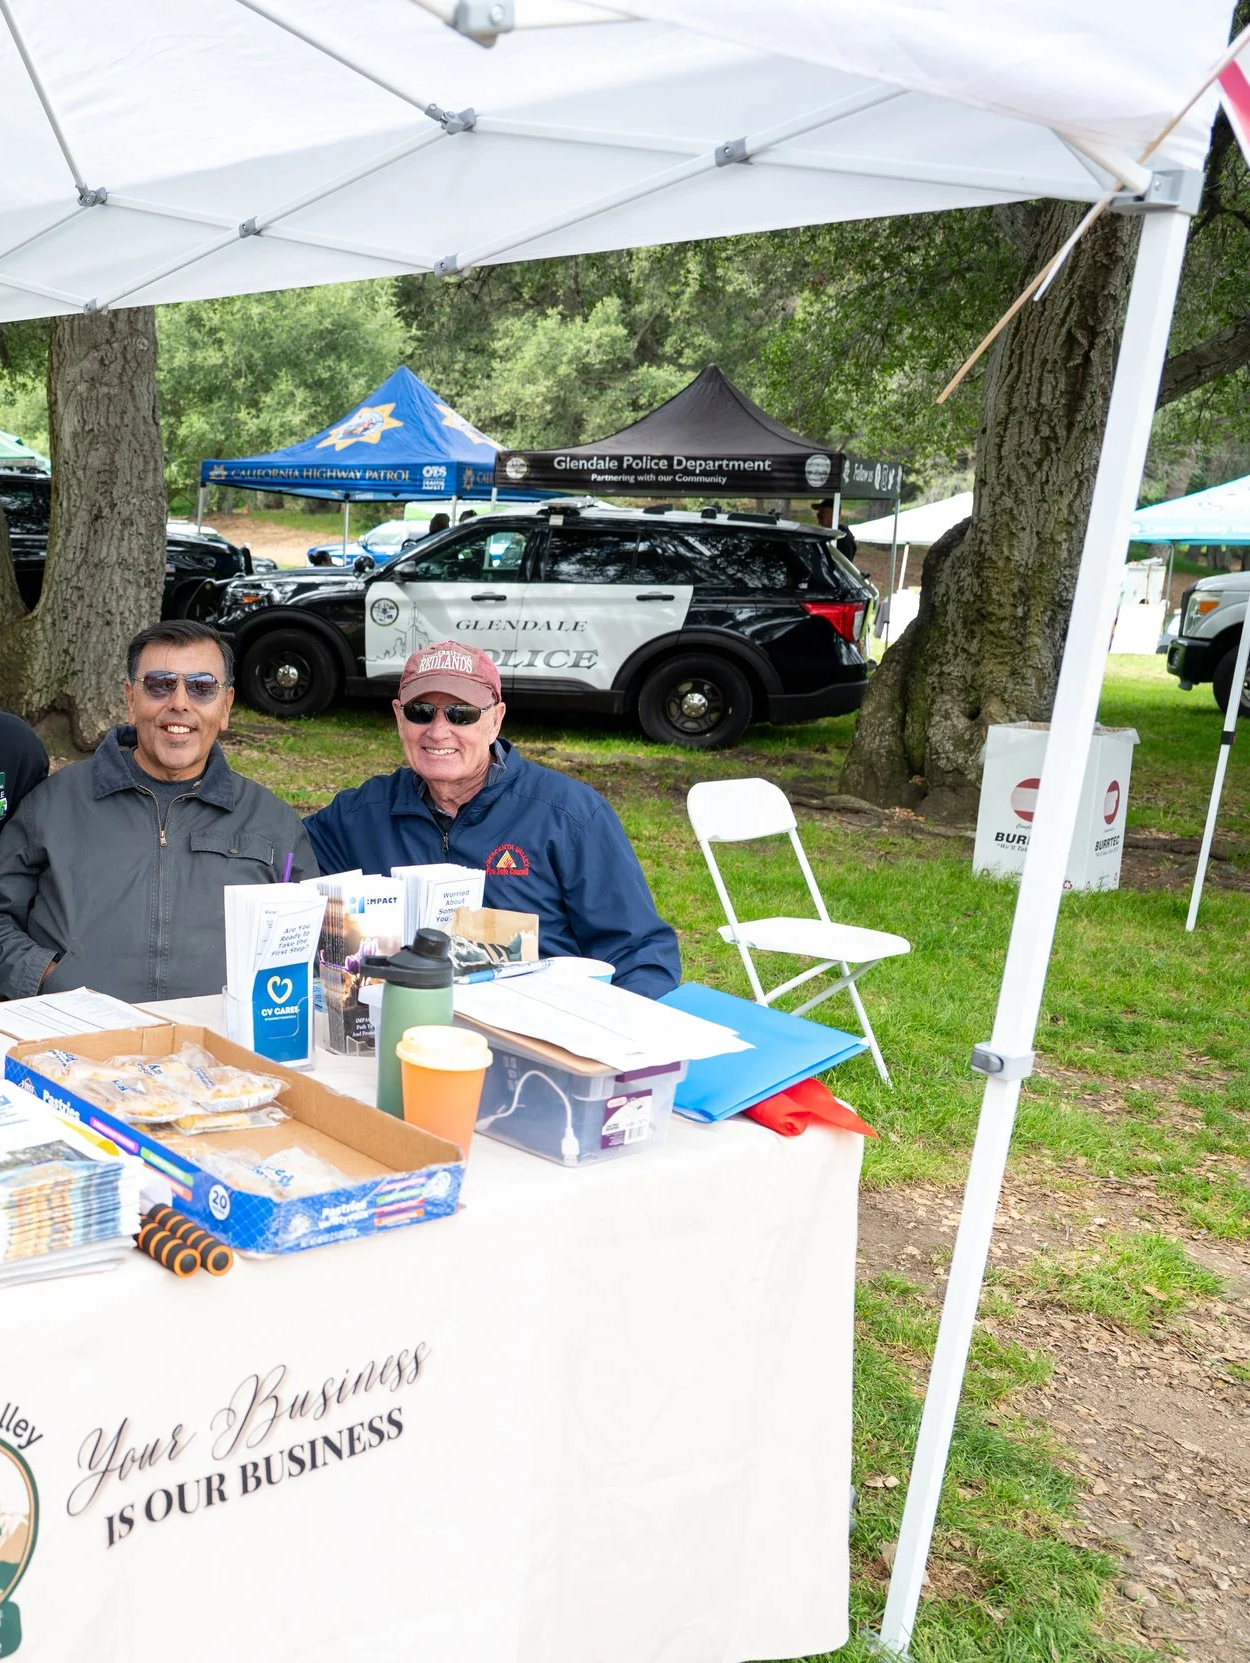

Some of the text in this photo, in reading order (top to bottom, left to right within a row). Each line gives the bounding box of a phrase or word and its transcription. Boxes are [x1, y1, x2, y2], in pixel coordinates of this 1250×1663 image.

[554, 455, 772, 473] Glendale Police Department
[231, 468, 411, 482] CALIFORNIA HIGHWAY PATROL
[591, 473, 727, 484] Partnering with our Community
[456, 619, 588, 632] GLENDALE
[418, 655, 472, 673] REDLANDS
[483, 649, 599, 669] OLICE
[1095, 835, 1120, 852] BURRTEC
[443, 890, 470, 899] Worried
[446, 898, 465, 907] About
[280, 933, 301, 943] Ready
[297, 938, 308, 946] the
[271, 944, 310, 957] First Step?
[261, 1006, 300, 1017] CV CARES
[43, 1089, 81, 1122] Pastries
[211, 1190, 228, 1208] 20
[66, 1340, 433, 1518] Your Business
[105, 1406, 406, 1550] IS OUR BUSINESS
